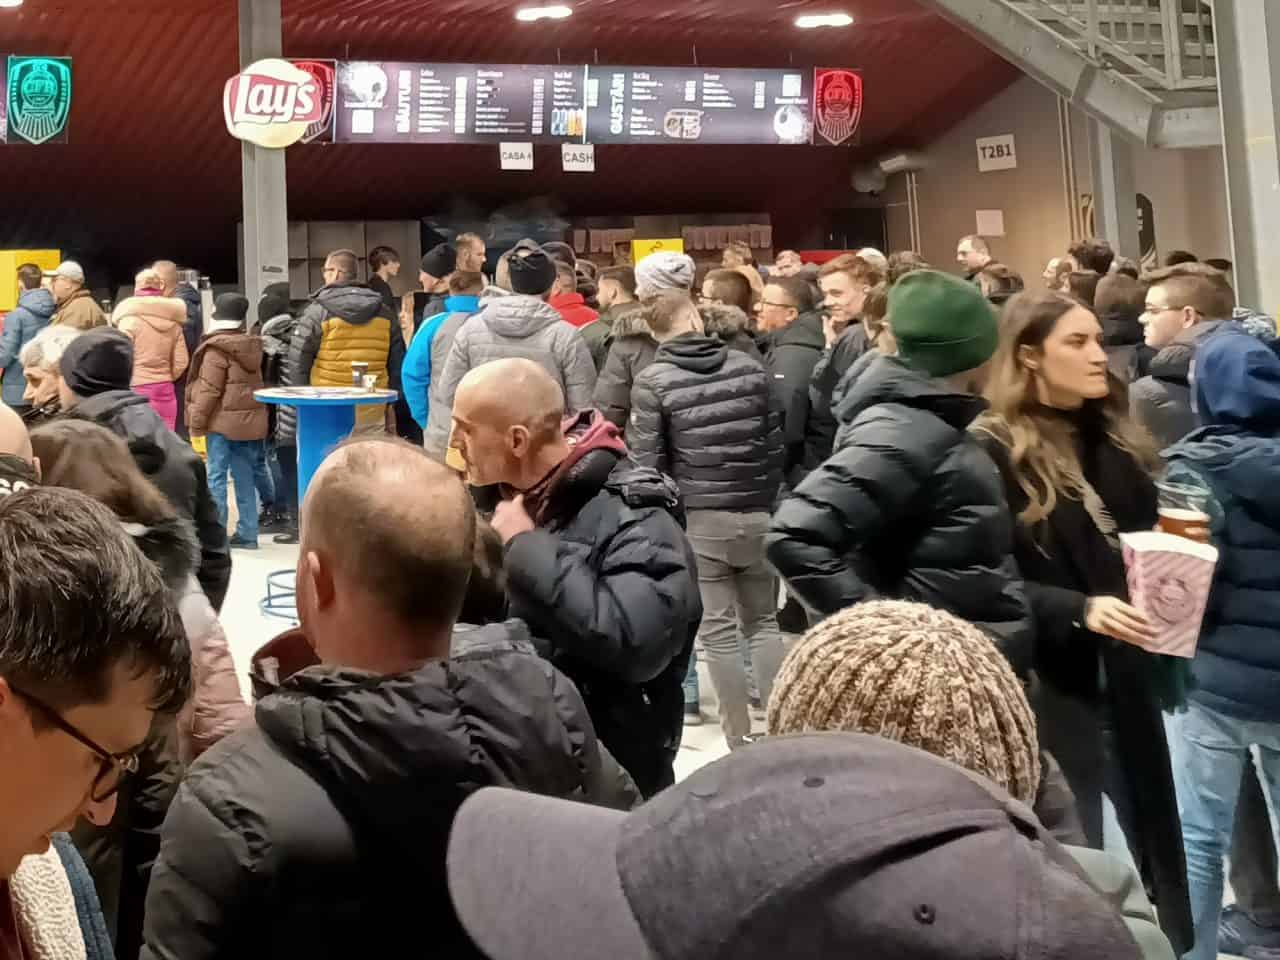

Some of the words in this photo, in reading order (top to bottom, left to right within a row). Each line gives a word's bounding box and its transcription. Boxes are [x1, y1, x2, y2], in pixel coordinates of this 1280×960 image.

[501, 151, 525, 161] CASA
[979, 143, 1012, 160] T2B1
[563, 152, 593, 163] CASH
